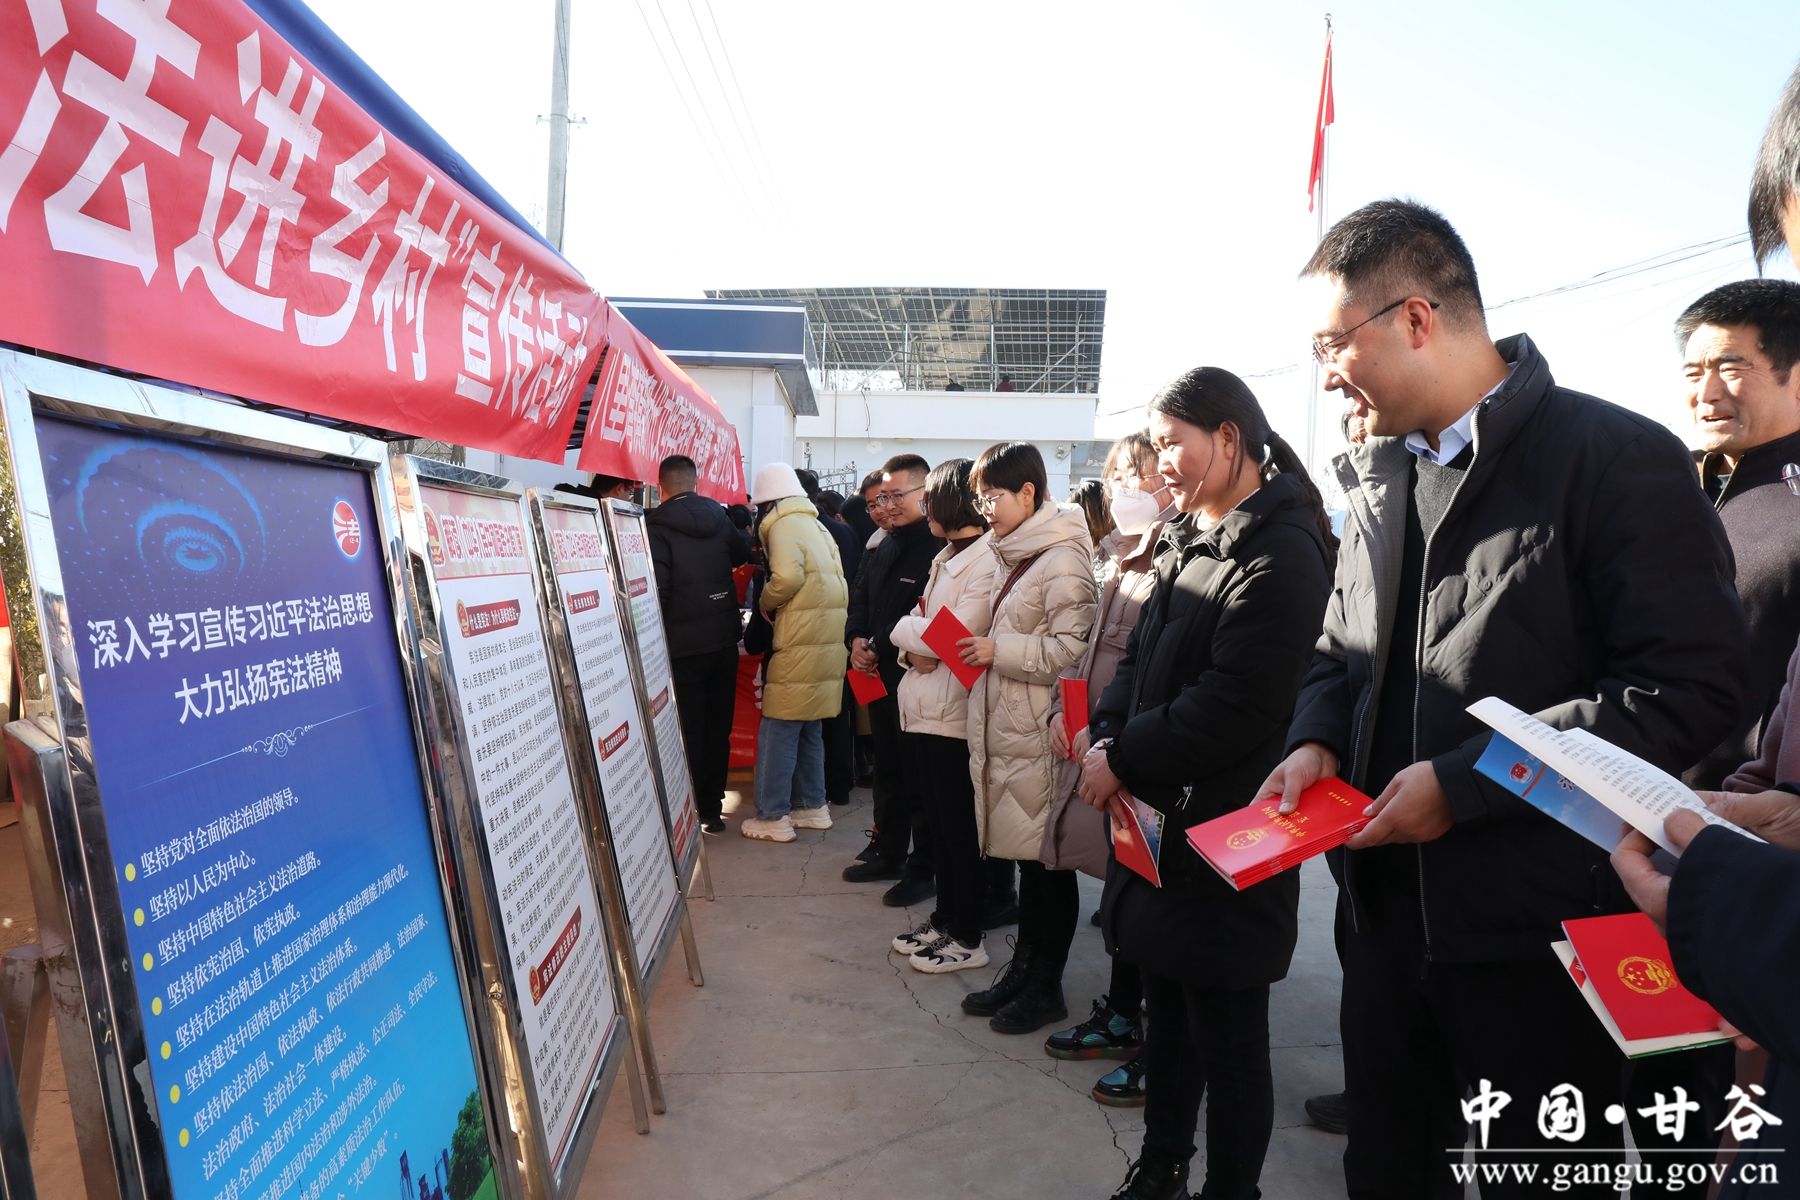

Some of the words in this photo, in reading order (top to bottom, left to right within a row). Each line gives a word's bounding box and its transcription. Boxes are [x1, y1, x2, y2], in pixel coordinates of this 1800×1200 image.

[88, 592, 374, 669] 深入学习宣传习近平法治思想
[175, 648, 343, 724] 大力弘扬宪法精神
[141, 787, 299, 879] 坚持党对全面依法治国的领导。
[150, 850, 256, 923] 坚持以人民为中心。
[158, 850, 321, 966] 坚持中国特色社会主义法治道路。
[185, 936, 358, 1096] 坚持建设中国特色社会主义法治体系。
